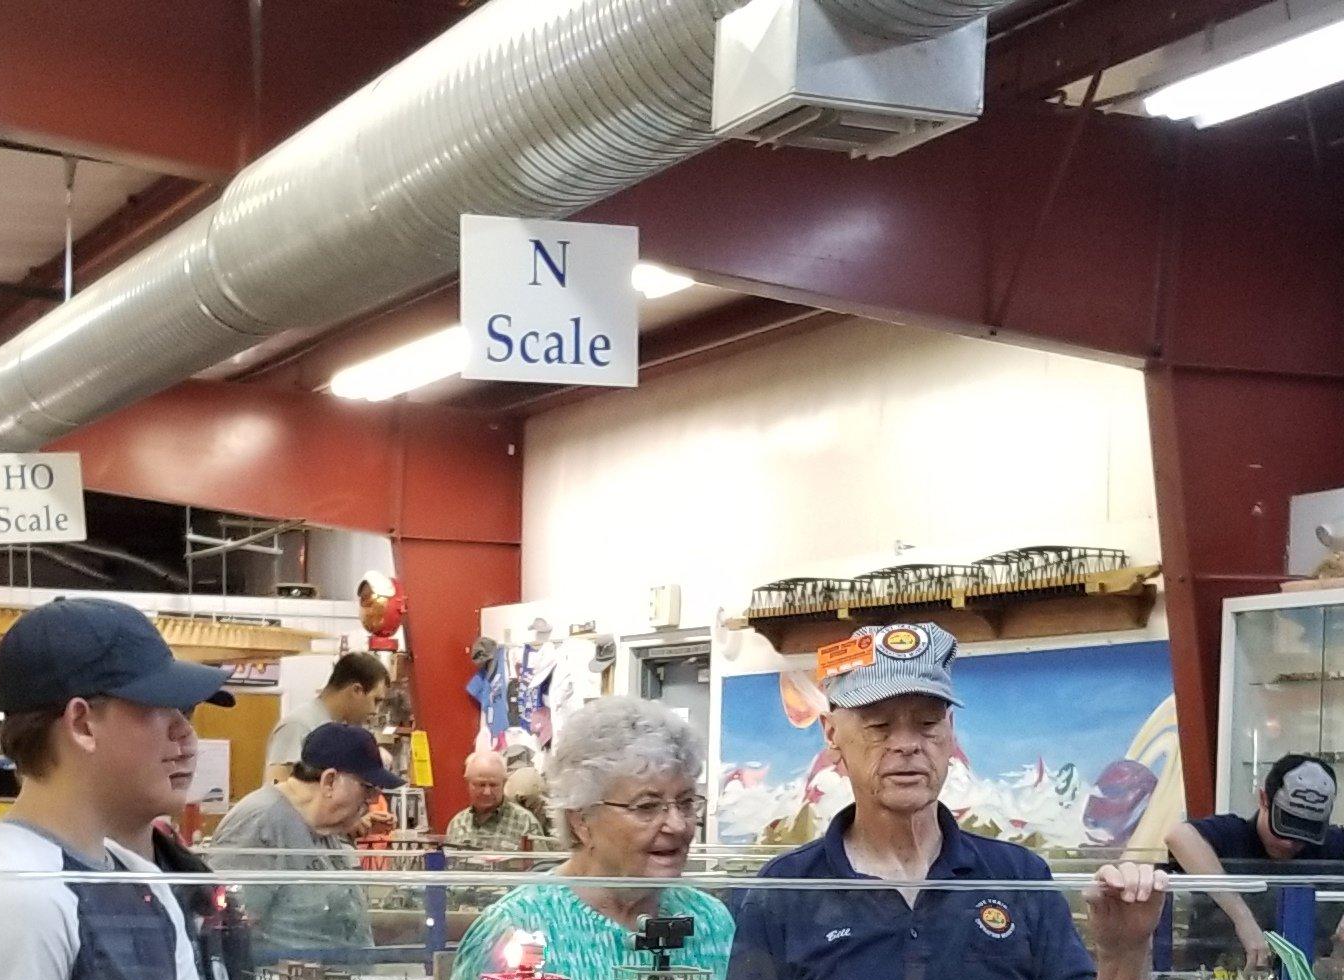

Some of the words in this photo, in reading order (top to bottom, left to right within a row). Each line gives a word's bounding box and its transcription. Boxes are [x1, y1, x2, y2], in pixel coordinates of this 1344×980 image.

[528, 239, 569, 288] N
[486, 313, 612, 367] Scale
[3, 464, 55, 491] HO
